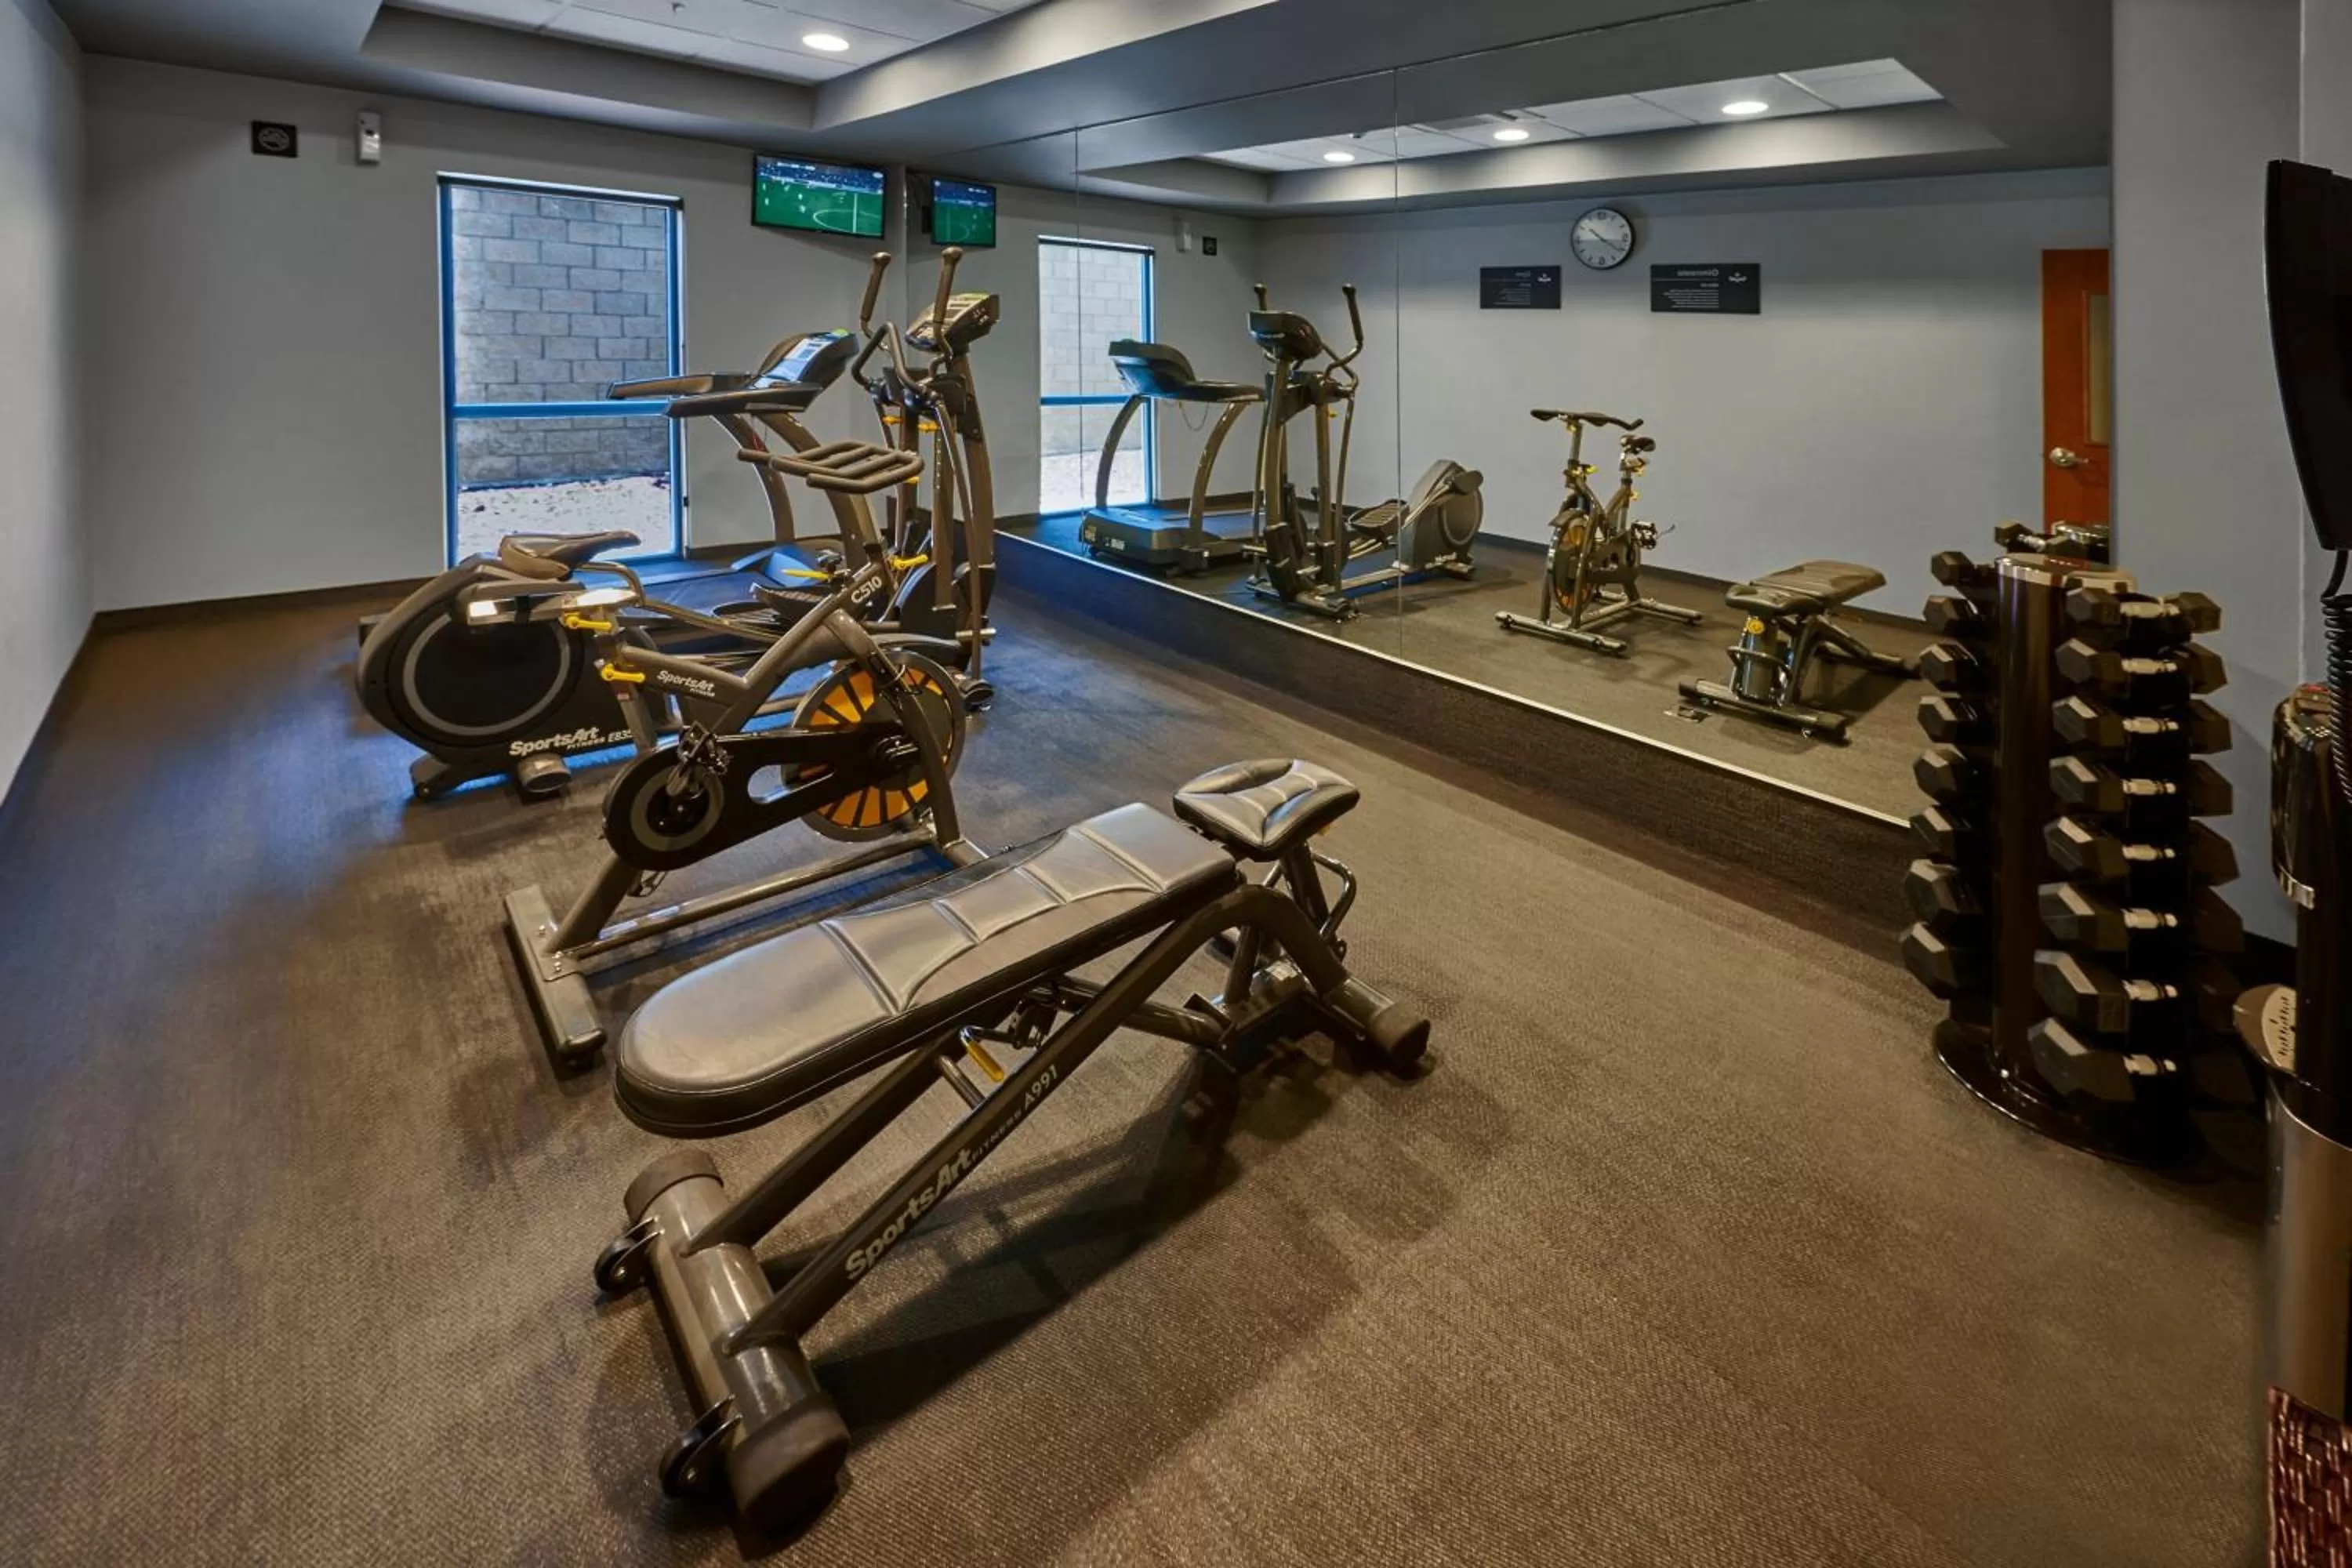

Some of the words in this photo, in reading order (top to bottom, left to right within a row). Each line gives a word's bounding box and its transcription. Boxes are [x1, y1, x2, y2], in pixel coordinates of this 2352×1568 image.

[851, 576, 882, 603] C510
[656, 670, 714, 692] SportsArt
[509, 726, 600, 756] SportsArt
[845, 1148, 972, 1280] SportsArt
[1024, 1063, 1058, 1110] A991
